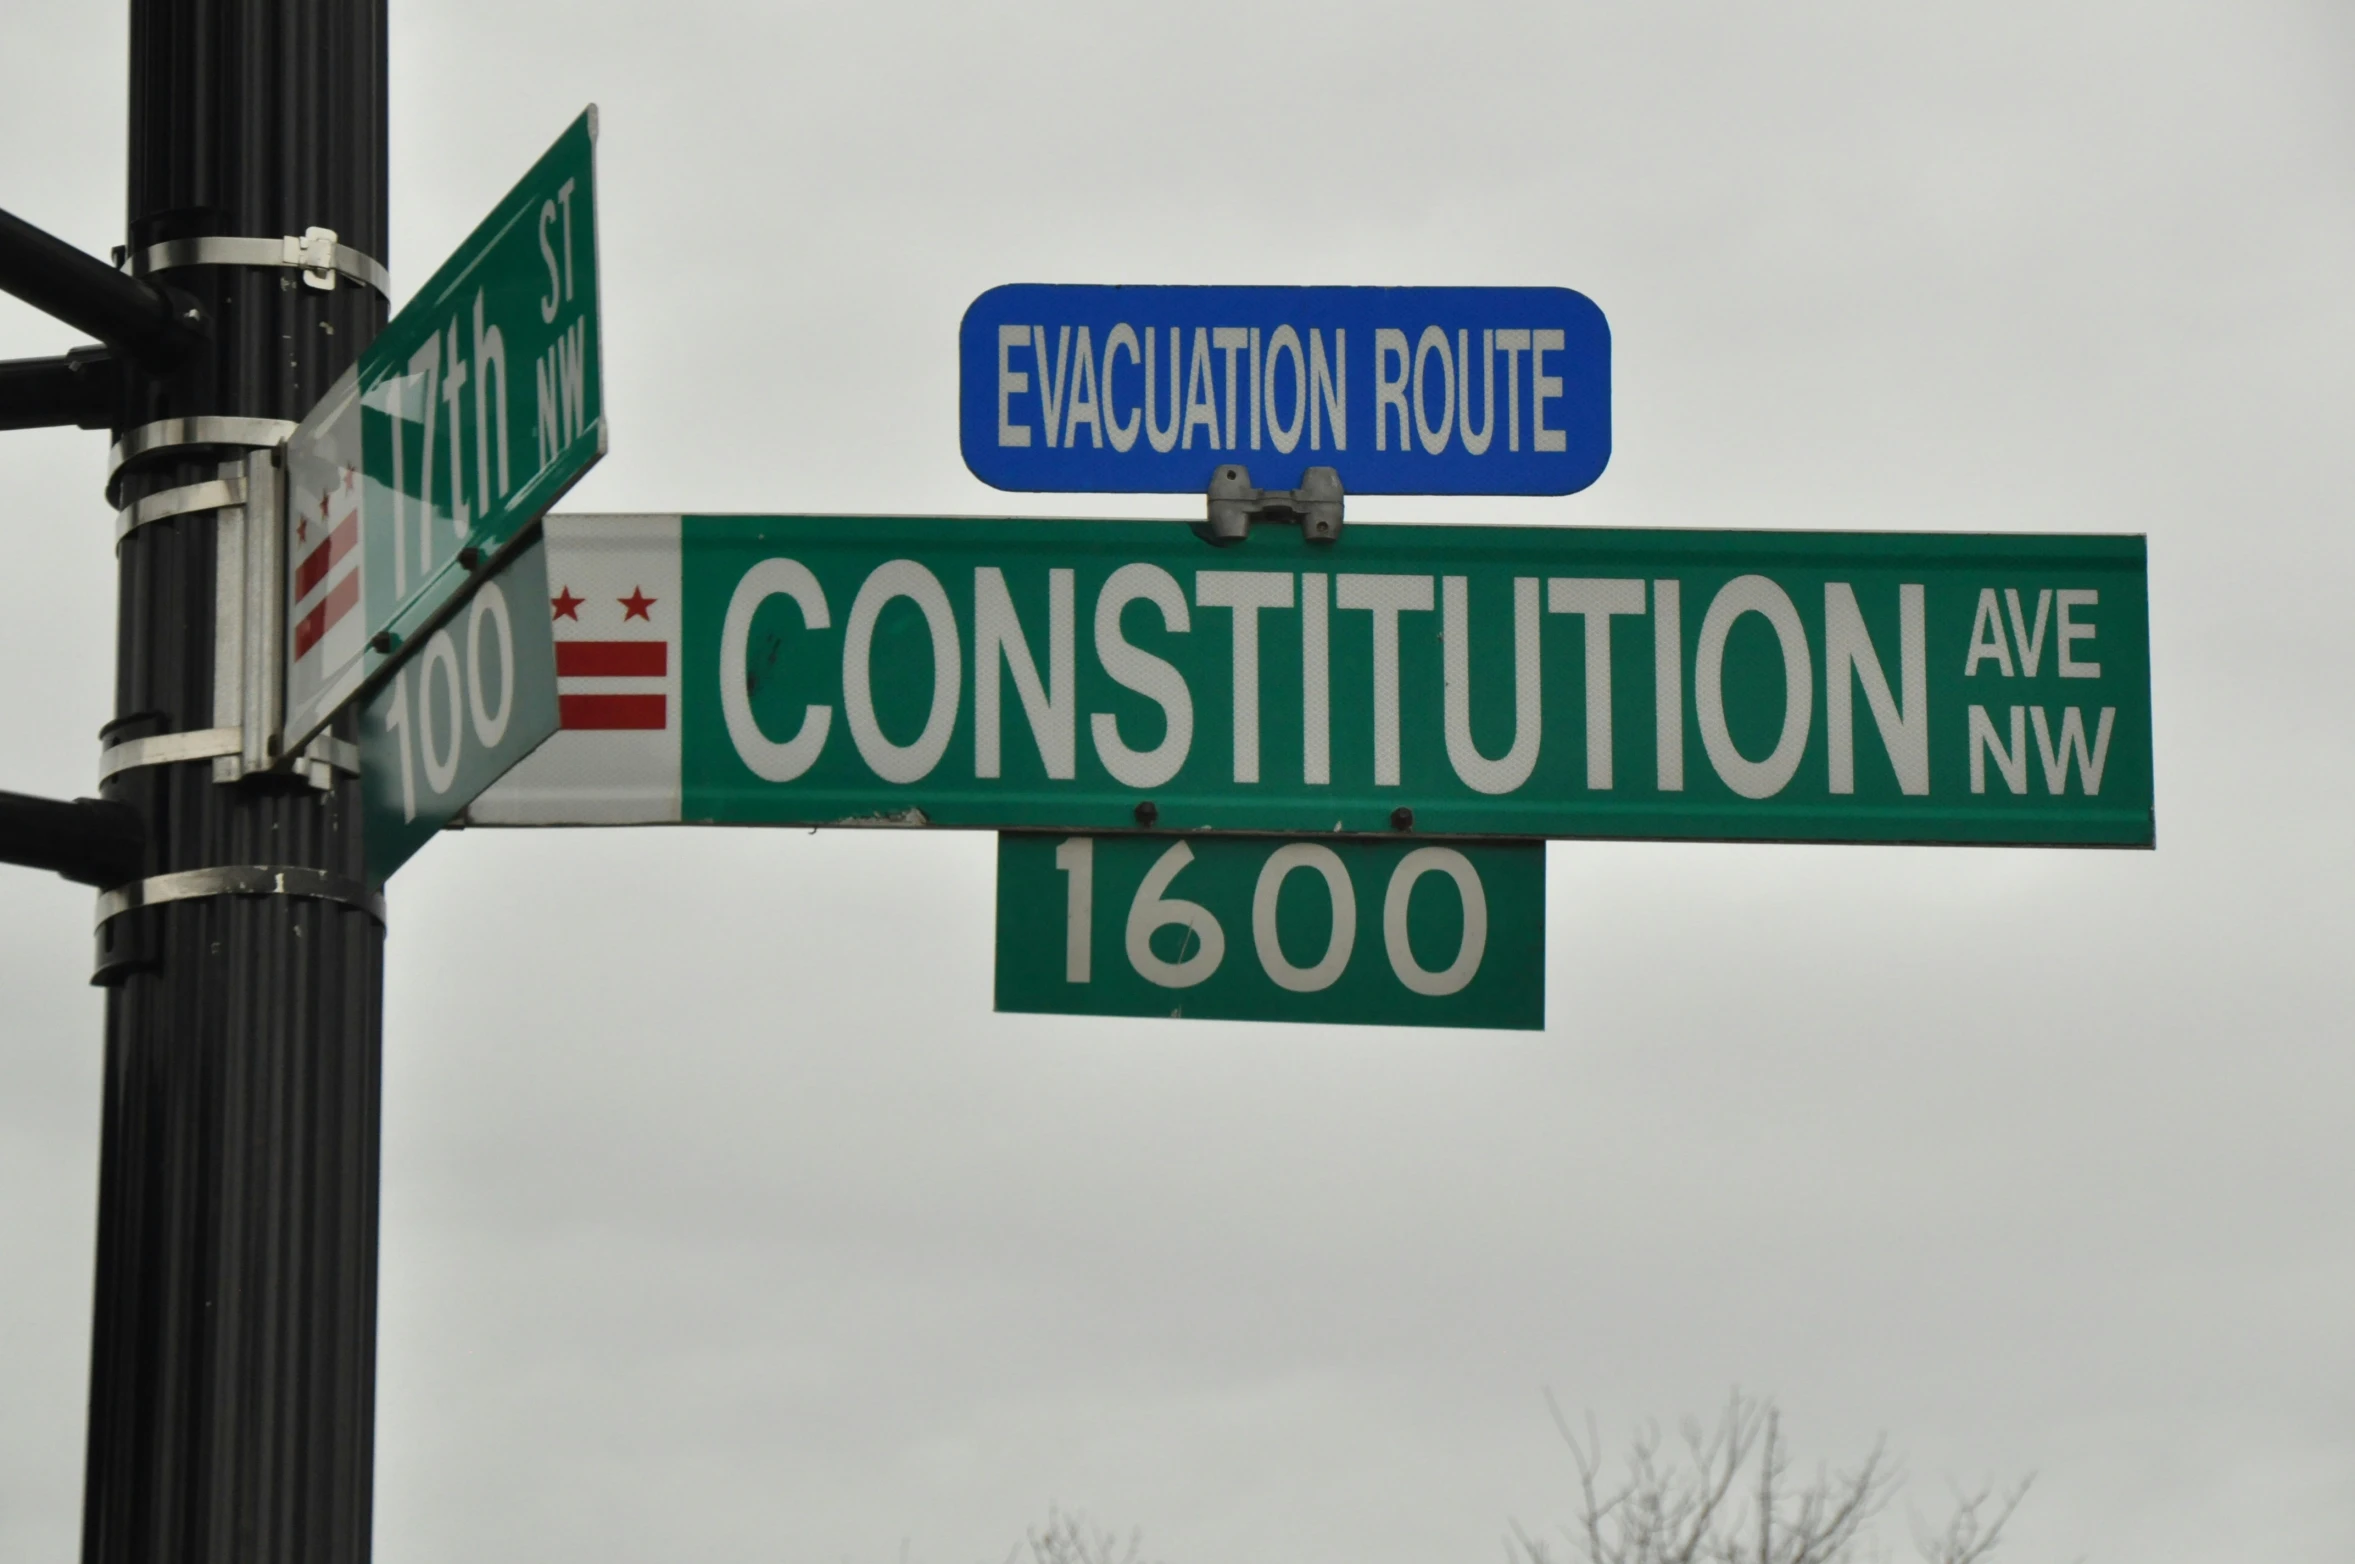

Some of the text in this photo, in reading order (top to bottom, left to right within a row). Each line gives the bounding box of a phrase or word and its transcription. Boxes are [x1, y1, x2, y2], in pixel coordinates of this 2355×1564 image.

[538, 176, 576, 324] ST
[385, 285, 510, 601] 17th
[536, 314, 586, 476] NW
[998, 322, 1567, 456] EVACUATION ROUTE
[386, 580, 515, 825] 100
[719, 556, 2101, 799] CONSTITUTION AVE
[1968, 704, 2117, 797] NW
[1054, 836, 1488, 997] 1600
